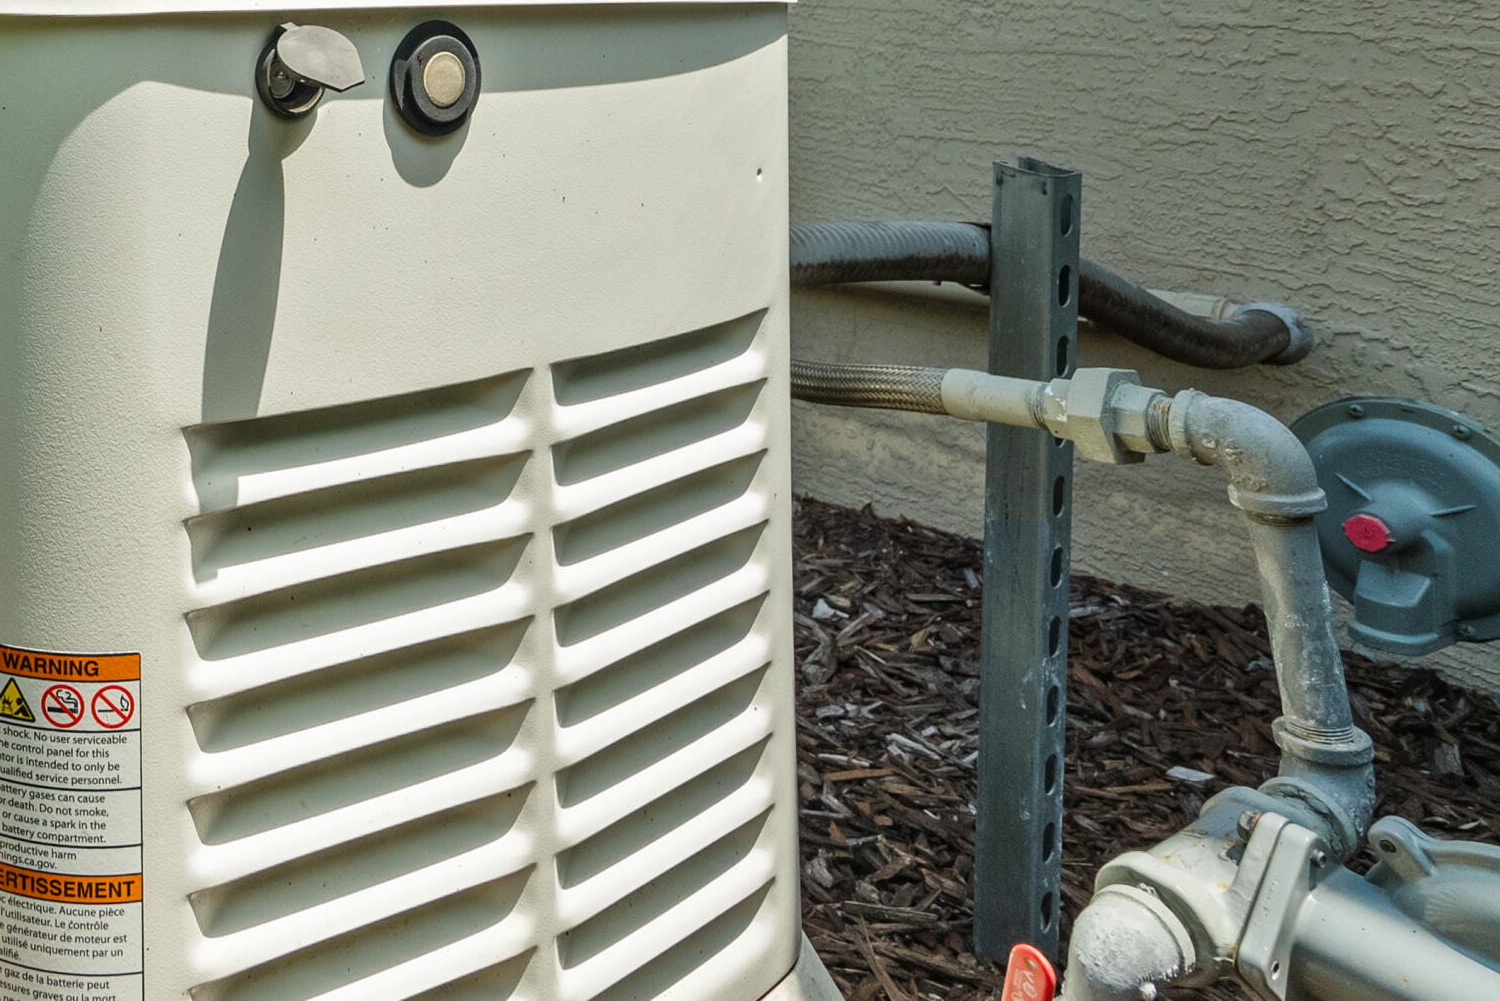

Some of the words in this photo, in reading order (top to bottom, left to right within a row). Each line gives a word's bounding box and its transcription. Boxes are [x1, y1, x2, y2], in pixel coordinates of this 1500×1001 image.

[3, 652, 99, 677] WARNING
[2, 726, 31, 739] shock.
[33, 731, 48, 742] No
[49, 735, 70, 744] user
[72, 734, 127, 745] serviceable
[10, 742, 44, 754] control
[46, 747, 73, 757] panel
[75, 747, 89, 758] for
[91, 748, 110, 758] this
[16, 754, 24, 765] is
[25, 756, 69, 770] intended
[71, 762, 82, 771] to
[83, 762, 105, 773] only
[107, 761, 120, 771] be
[35, 773, 68, 784] service
[70, 774, 122, 786] personnel.
[28, 790, 55, 801] gases
[57, 794, 75, 802] can
[77, 795, 105, 803] cause
[7, 797, 37, 811] death.
[39, 802, 53, 814] Do
[55, 807, 72, 816] not
[74, 807, 109, 817] smoke,
[1, 810, 12, 819] or
[13, 813, 40, 825] cause
[41, 818, 48, 826] a
[50, 819, 76, 829] spark
[78, 820, 88, 830] in
[89, 820, 106, 830] the
[1, 821, 35, 839] battery
[36, 831, 106, 843] compartment.
[51, 848, 77, 860] harm
[58, 905, 96, 917] Aucune
[98, 907, 125, 919] pièce
[54, 918, 66, 929] Le
[6, 923, 57, 941] générateur
[59, 932, 72, 943] de
[74, 935, 110, 944] moteur
[112, 934, 127, 944] est
[1, 935, 28, 949] utilisé
[30, 943, 89, 957] uniquement
[92, 949, 108, 959] par
[110, 949, 123, 957] un
[4, 967, 20, 979] gaz
[22, 971, 34, 982] de
[36, 973, 44, 984] la
[46, 975, 84, 989] batterie
[86, 981, 110, 991] peut
[32, 989, 63, 1001] graves
